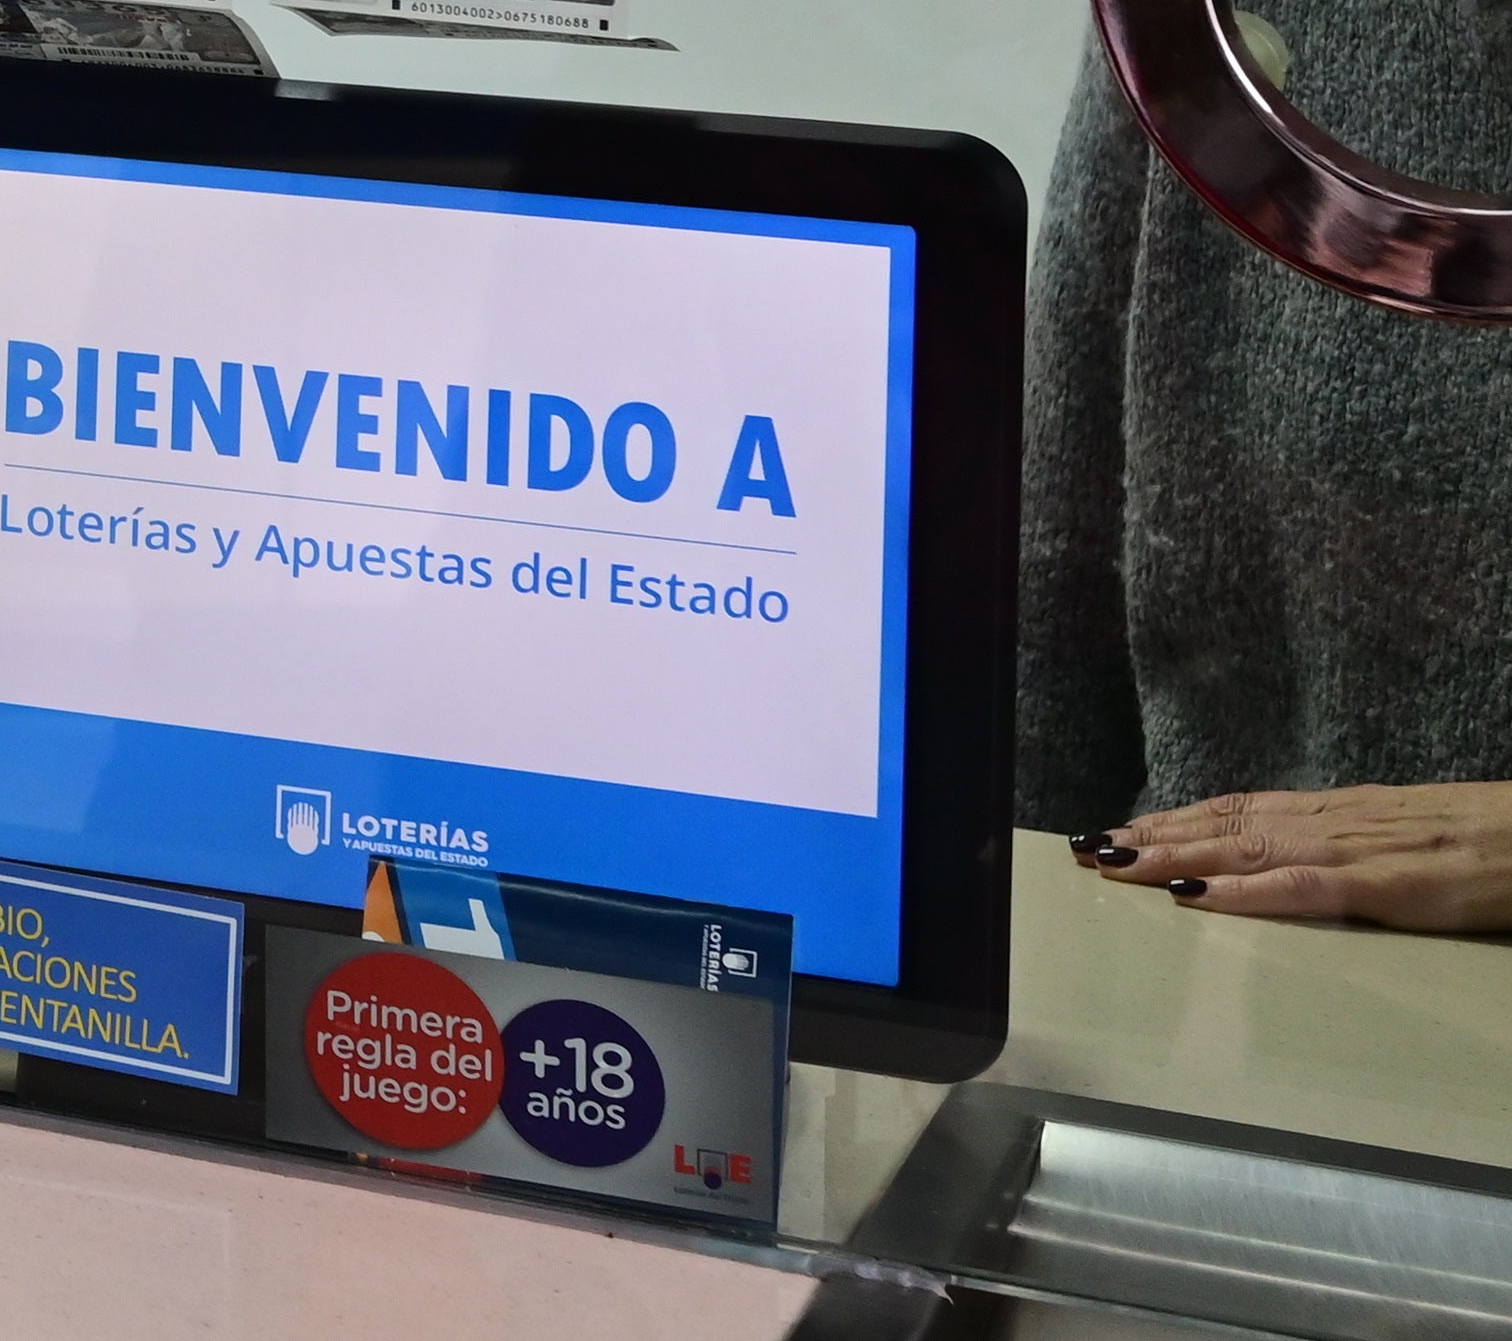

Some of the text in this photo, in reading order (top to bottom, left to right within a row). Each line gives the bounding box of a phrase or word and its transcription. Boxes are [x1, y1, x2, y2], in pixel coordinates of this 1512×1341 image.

[5, 339, 798, 521] BIENVENIDO A
[0, 492, 791, 623] Loterías y Apuestas del Estado
[342, 811, 489, 853] LOTERÍAS
[325, 989, 484, 1044] Primera
[316, 1028, 494, 1082] regla del
[519, 1036, 634, 1100] +18
[340, 1064, 468, 1115] juego:
[526, 1088, 626, 1130] años
